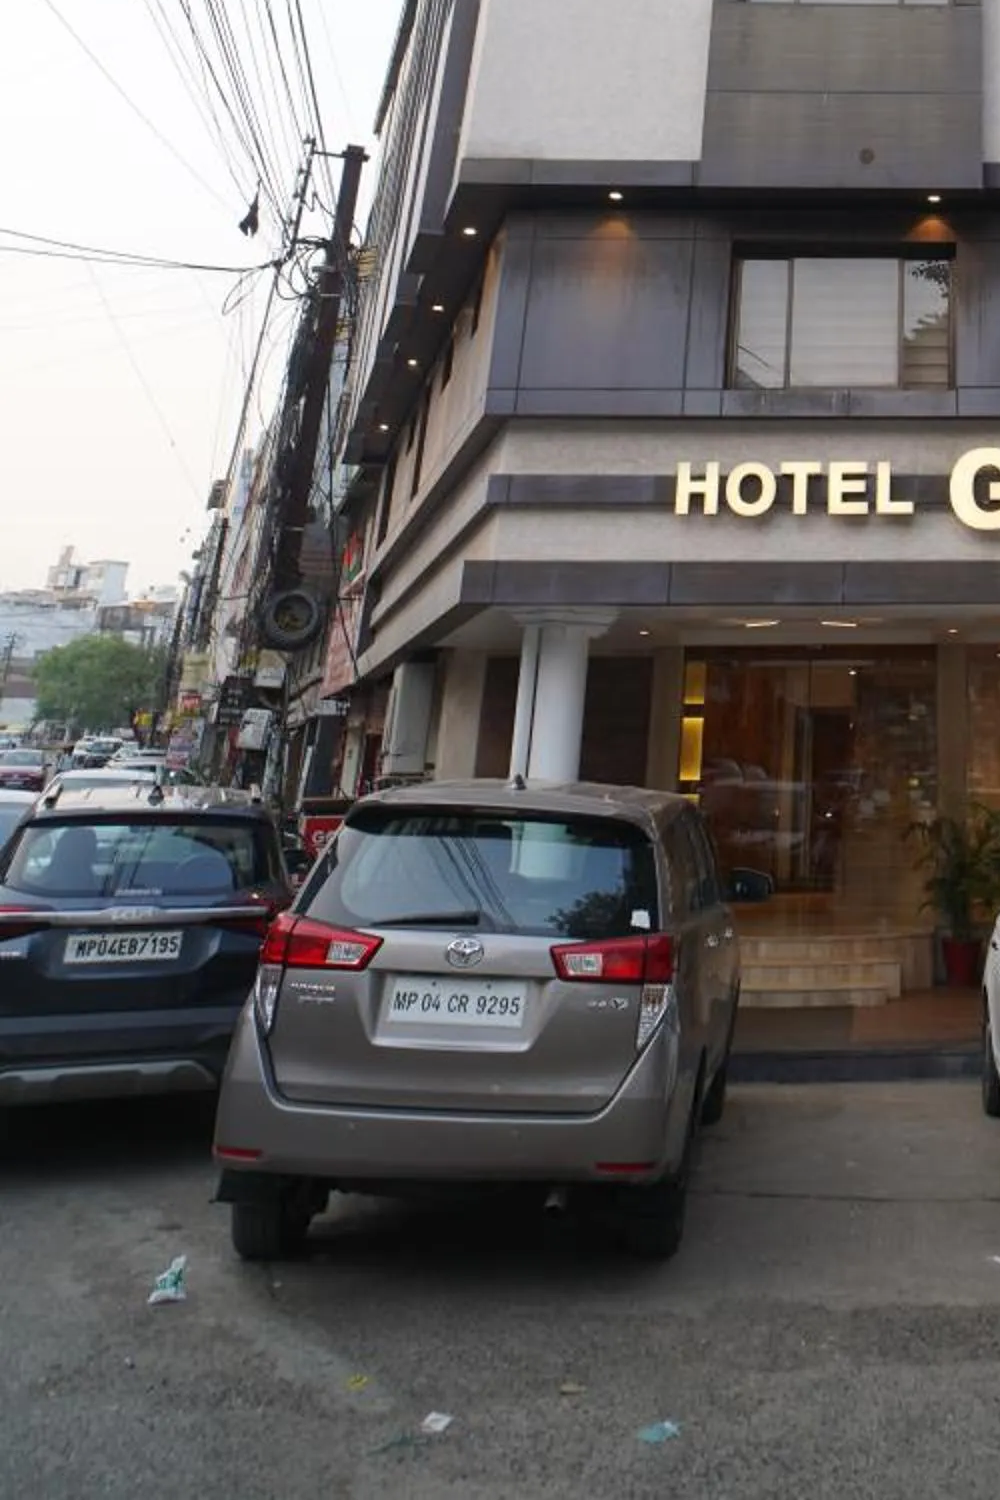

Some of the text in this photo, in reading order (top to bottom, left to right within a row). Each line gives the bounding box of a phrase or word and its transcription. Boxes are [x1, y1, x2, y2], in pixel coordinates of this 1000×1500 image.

[674, 460, 915, 517] HOTEL
[75, 935, 179, 958] MP04EB7195
[393, 991, 520, 1015] MP 04 CR 9295
